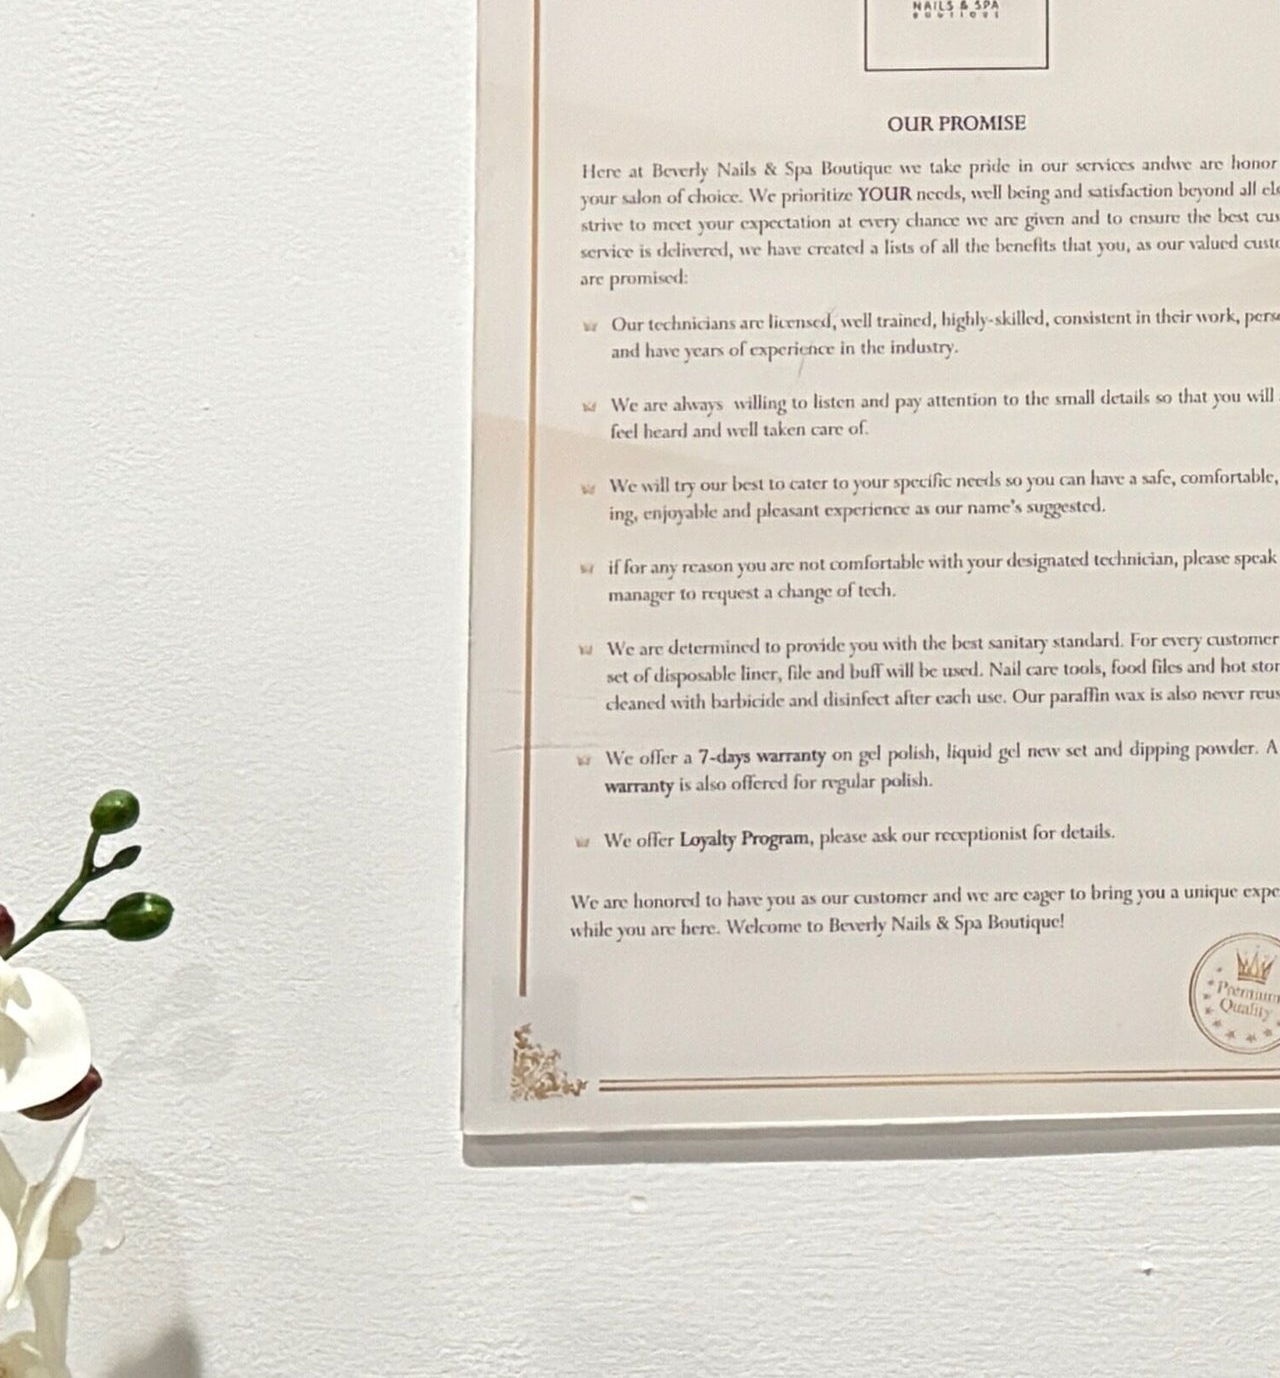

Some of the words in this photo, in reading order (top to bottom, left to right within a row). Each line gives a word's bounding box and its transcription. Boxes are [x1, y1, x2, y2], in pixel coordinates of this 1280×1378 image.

[912, 0, 954, 12] NAILS
[959, 0, 969, 11] &
[974, 0, 1000, 11] SPA
[887, 114, 935, 133] OUR
[938, 113, 1027, 133] PROMISE
[603, 831, 632, 849] We
[636, 830, 675, 849] offer
[679, 828, 738, 855] Loyalty
[740, 828, 815, 853] Program,
[819, 826, 868, 852] please
[871, 824, 898, 844] ask
[901, 830, 931, 844] our
[934, 825, 1028, 849] receptionist
[1032, 822, 1057, 842] for
[1060, 821, 1116, 841] details.
